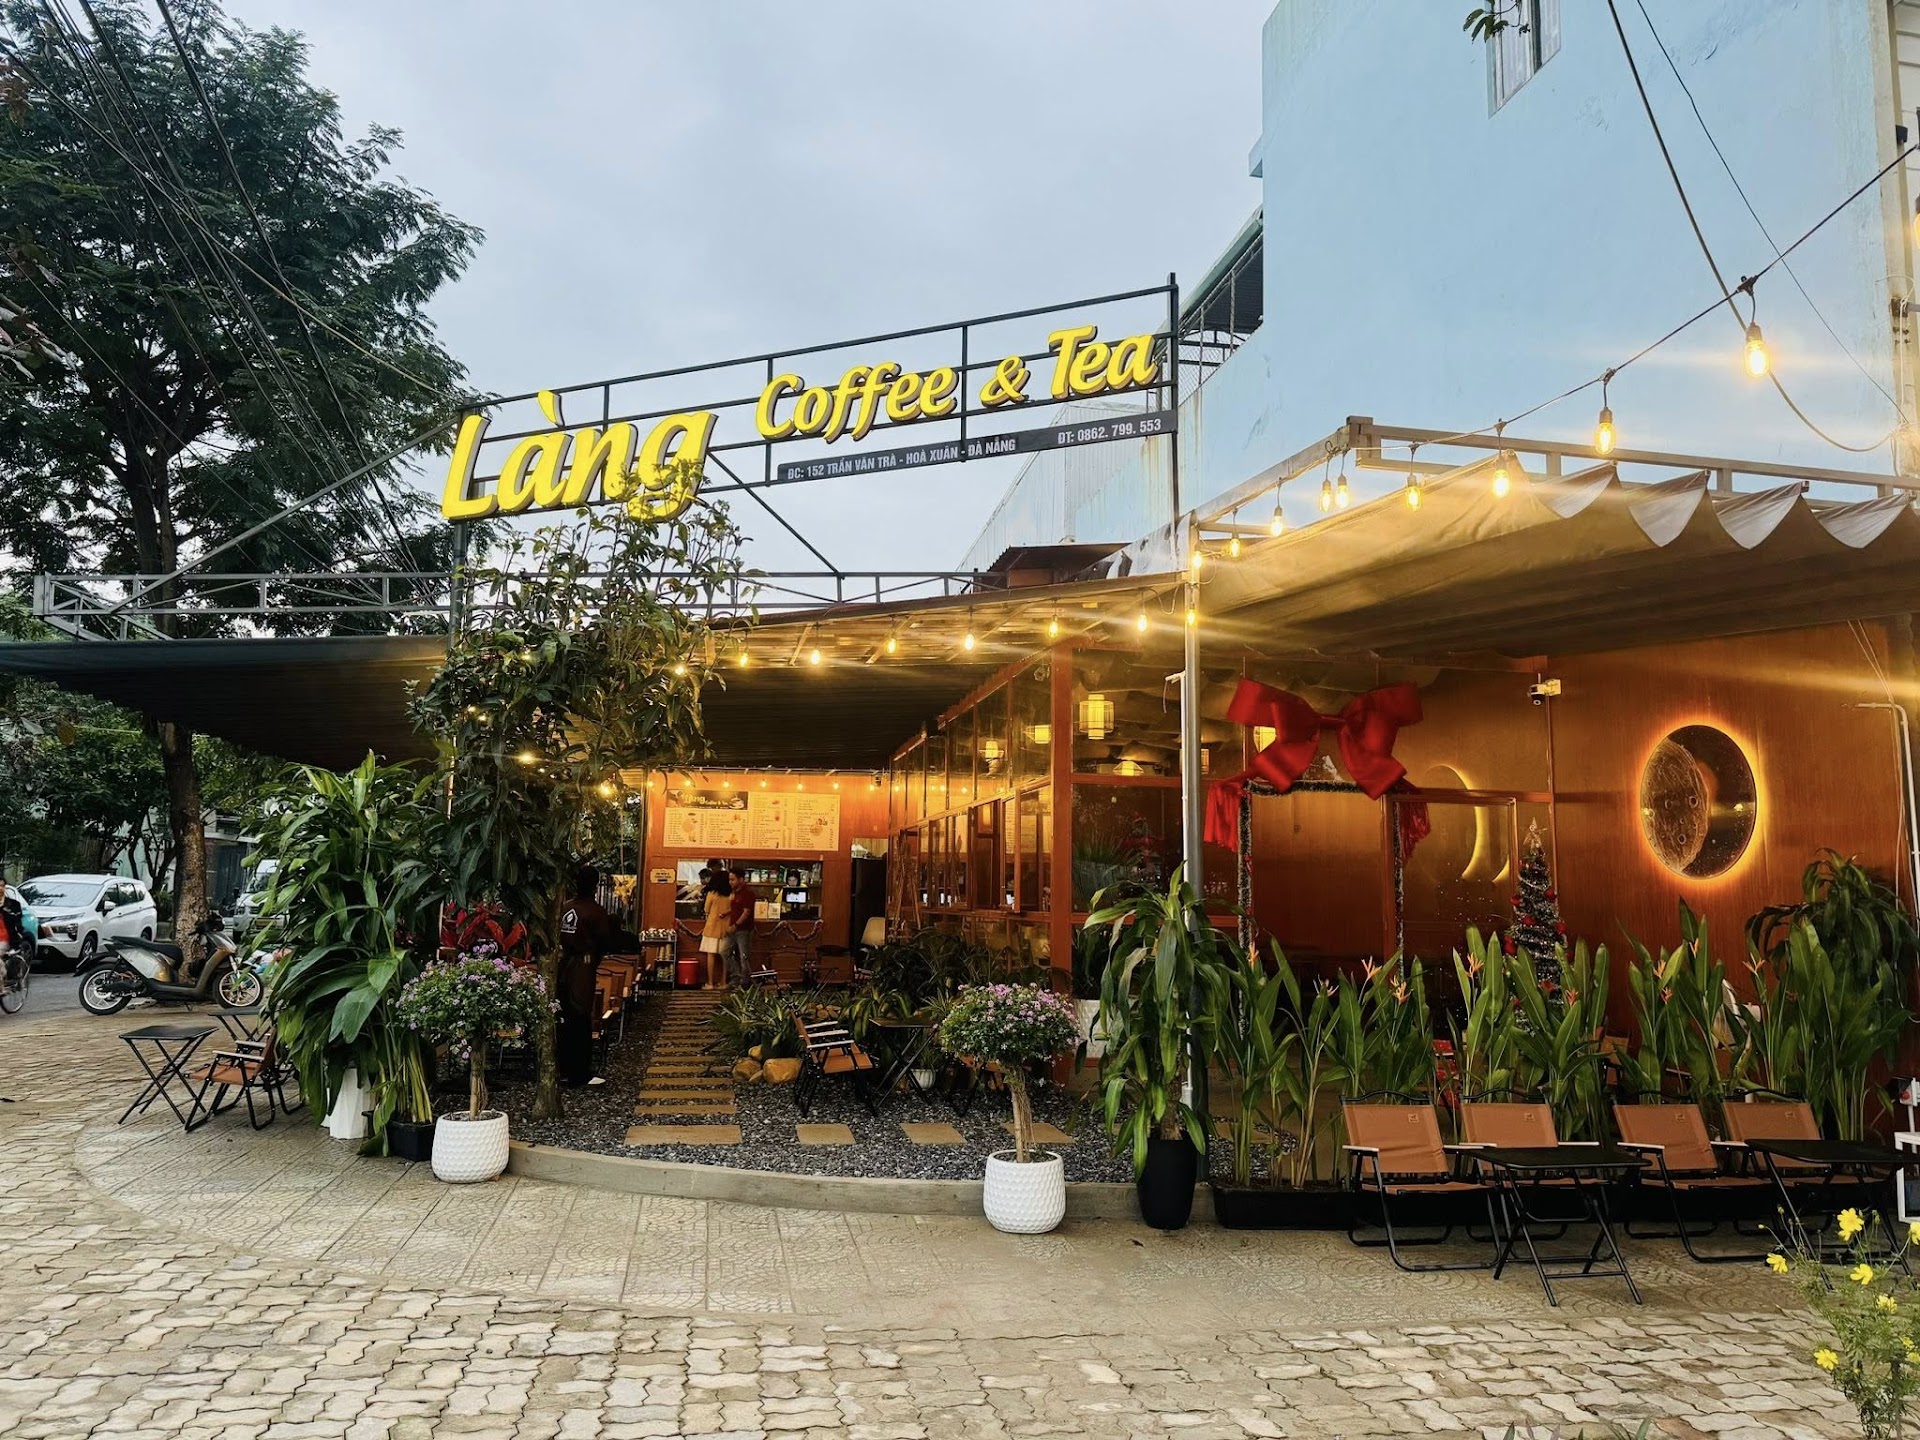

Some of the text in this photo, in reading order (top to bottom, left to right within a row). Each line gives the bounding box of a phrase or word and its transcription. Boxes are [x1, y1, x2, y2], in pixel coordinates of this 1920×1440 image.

[441, 324, 1163, 522] Làng Coffee & Tea
[1057, 418, 1161, 444] ĐT: 0862. 799. 553
[787, 467, 804, 480] ĐC:
[807, 465, 825, 477] 152
[877, 453, 896, 468] TRÀ
[905, 449, 926, 465] HOÀ
[929, 445, 958, 462] XUÂN
[967, 441, 983, 457] ĐÀ
